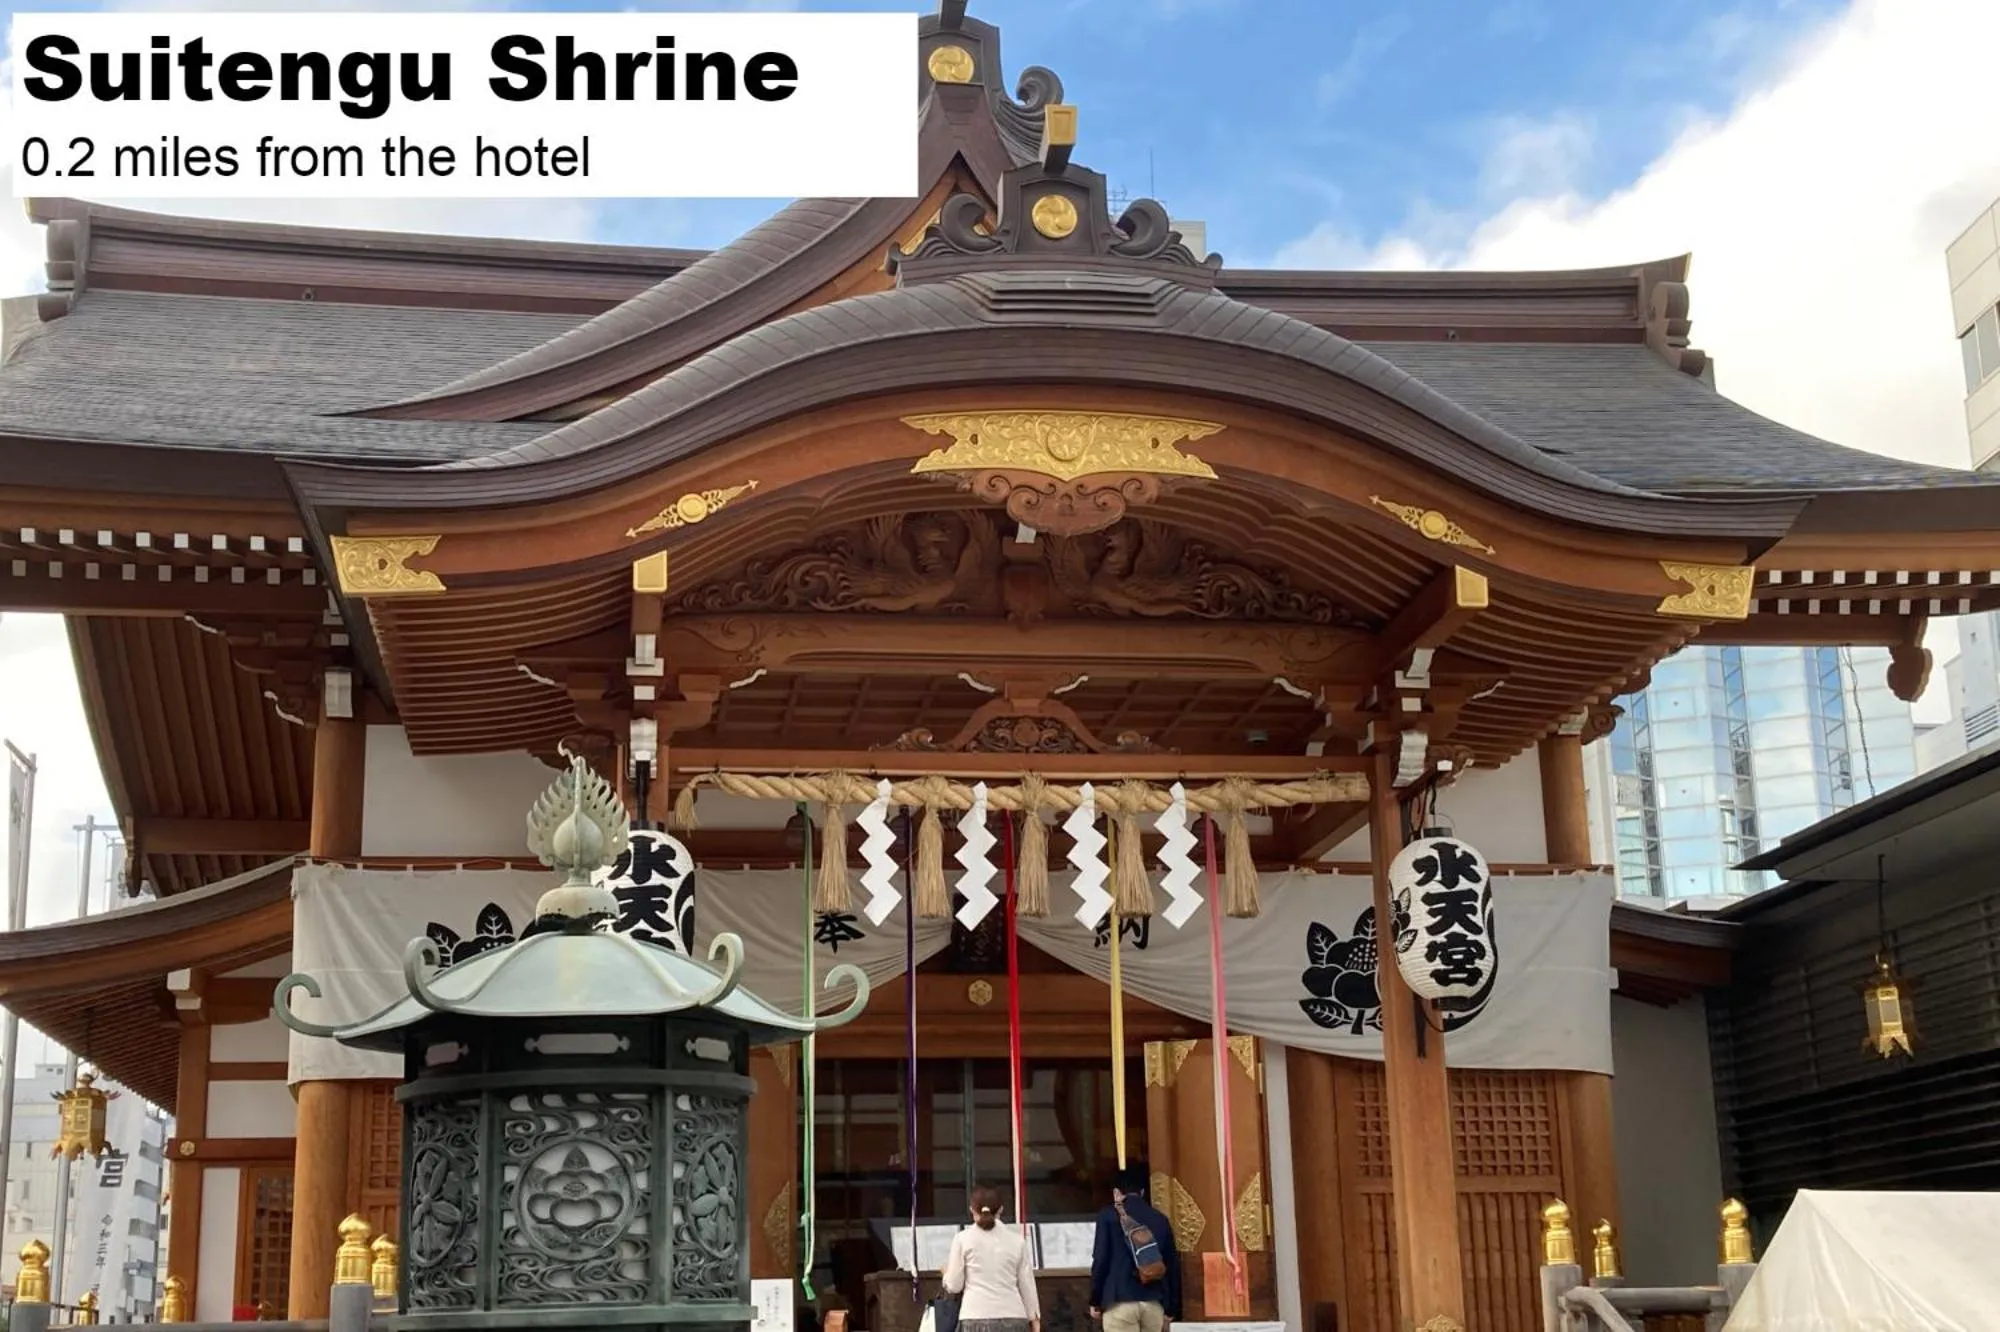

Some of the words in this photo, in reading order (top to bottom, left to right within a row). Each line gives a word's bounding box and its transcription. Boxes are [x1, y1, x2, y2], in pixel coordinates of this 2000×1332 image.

[608, 835, 681, 951] 水天
[1412, 842, 1486, 986] 水天宮
